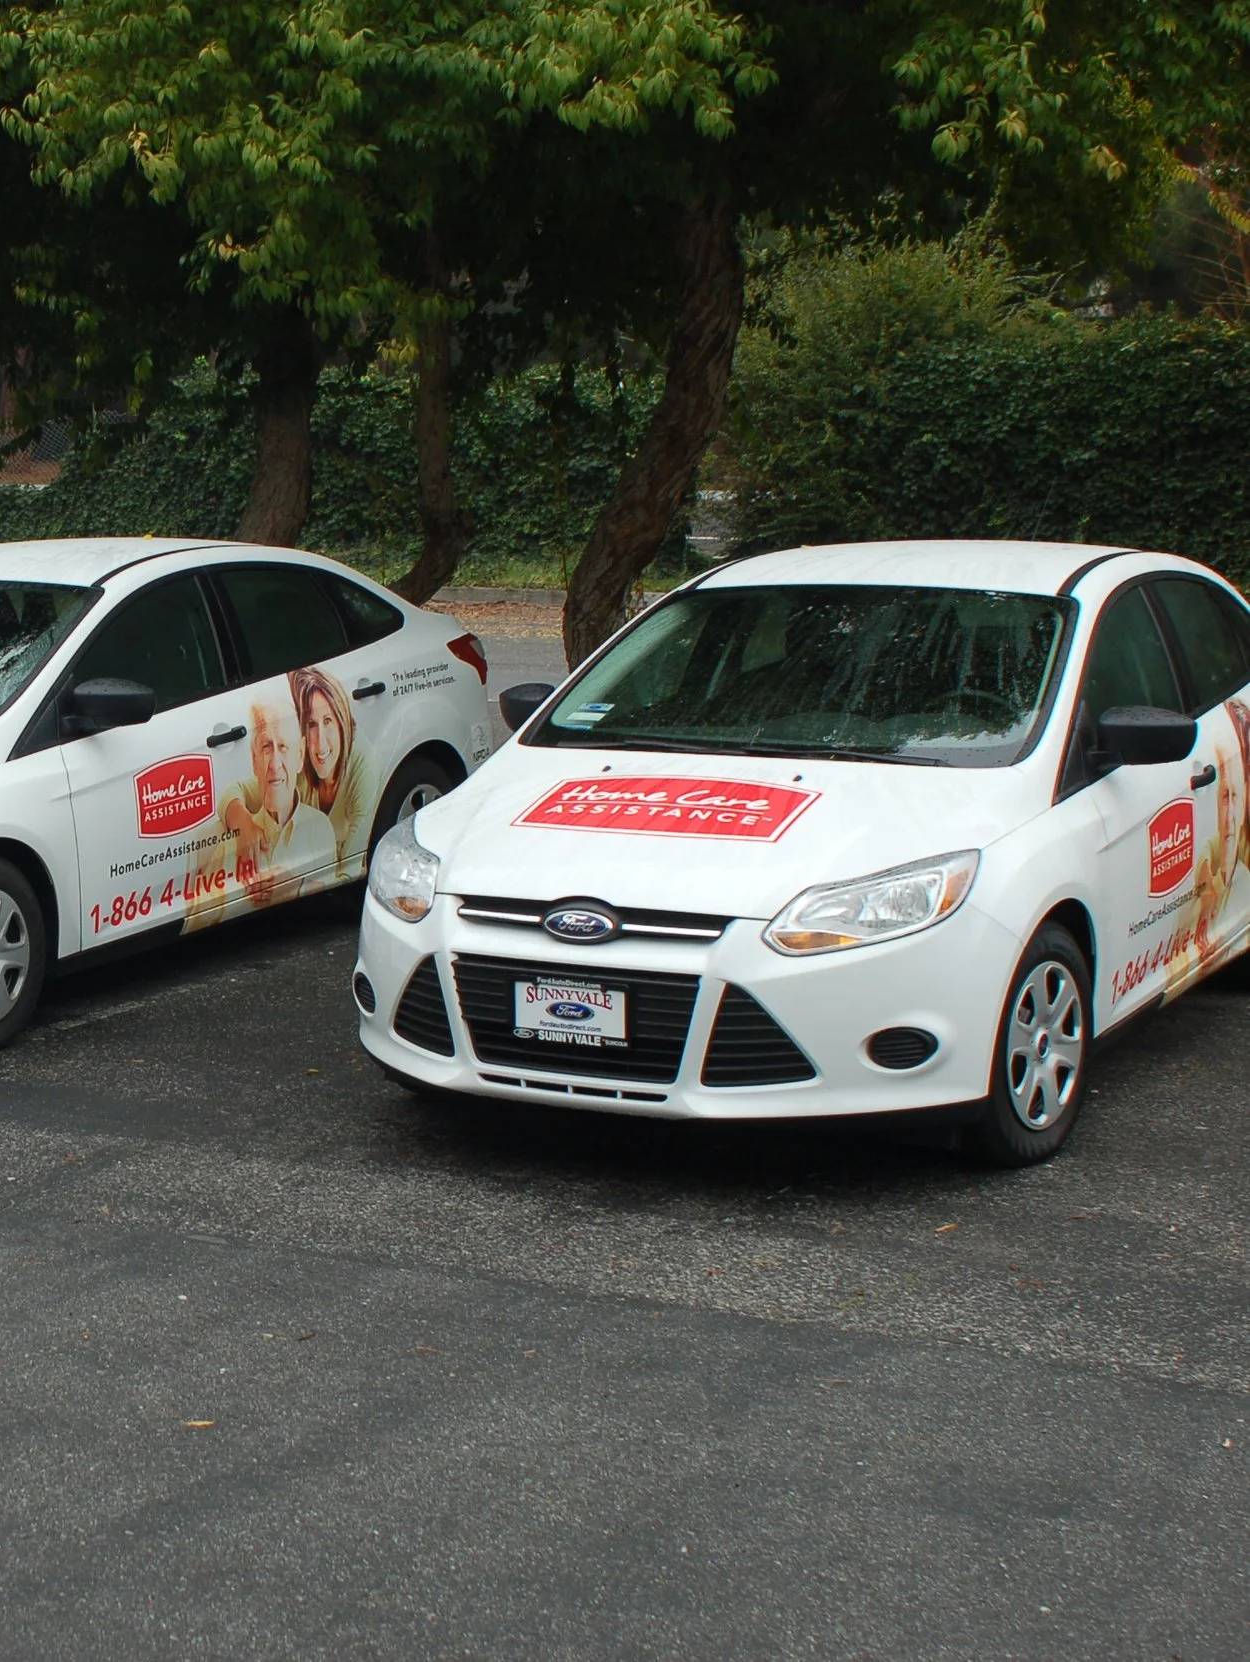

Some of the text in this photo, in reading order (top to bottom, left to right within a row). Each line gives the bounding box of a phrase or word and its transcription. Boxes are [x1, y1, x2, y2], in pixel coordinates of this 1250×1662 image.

[392, 661, 449, 682] The leading provider
[392, 686, 399, 697] of
[142, 775, 206, 805] Home Care
[561, 784, 771, 810] Home Care
[144, 795, 208, 822] ASSISTANCE
[545, 804, 761, 826] ASSISTANCE
[110, 827, 241, 878] HomeCareAssistance.com
[1152, 822, 1192, 858] Home Care
[1152, 846, 1192, 878] ASSISTANCE
[90, 885, 152, 934] 1-866
[558, 913, 597, 932] Ford
[1112, 948, 1150, 1005] 1-866
[526, 985, 613, 1010] SUNNYVALE
[555, 1003, 584, 1018] Ford
[538, 1030, 602, 1047] SUNNYVALE
